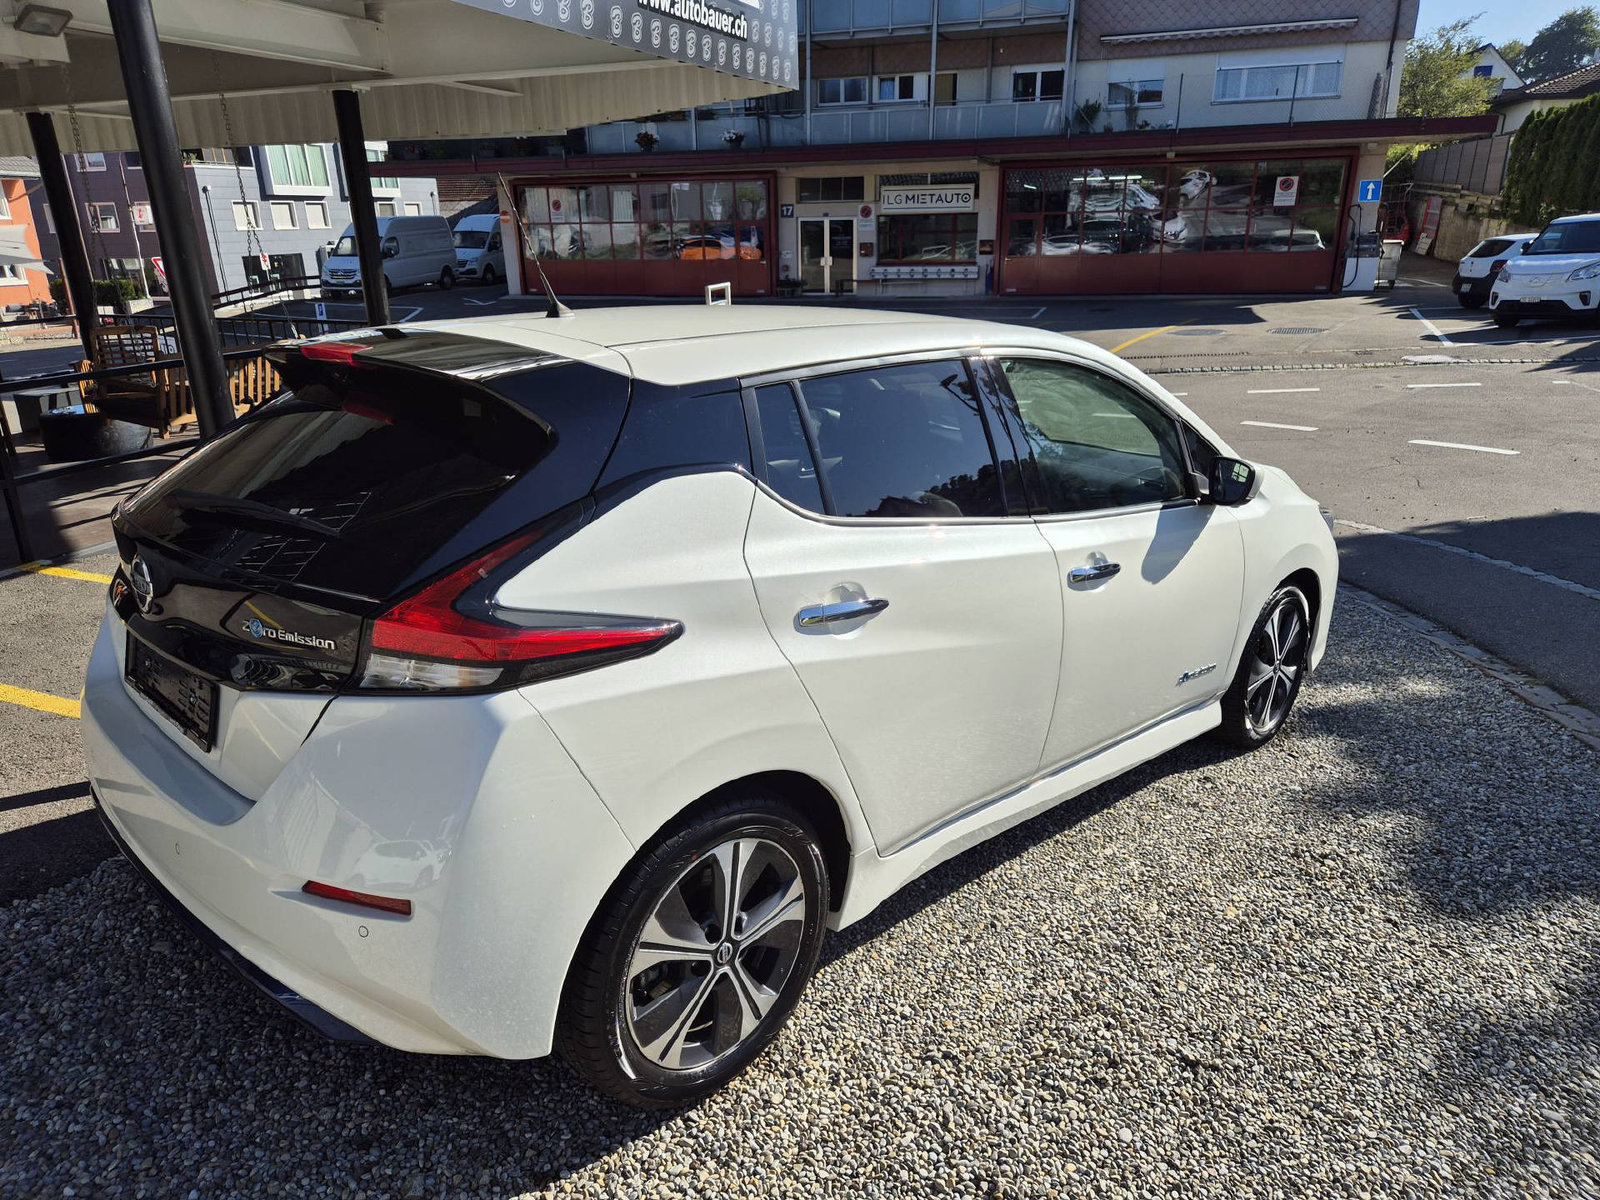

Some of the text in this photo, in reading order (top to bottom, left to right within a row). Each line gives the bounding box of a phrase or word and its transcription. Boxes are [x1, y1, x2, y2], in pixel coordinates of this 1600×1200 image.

[882, 193, 971, 205] ILG MIETAUTO
[781, 206, 793, 216] 17
[277, 629, 335, 650] Emission
